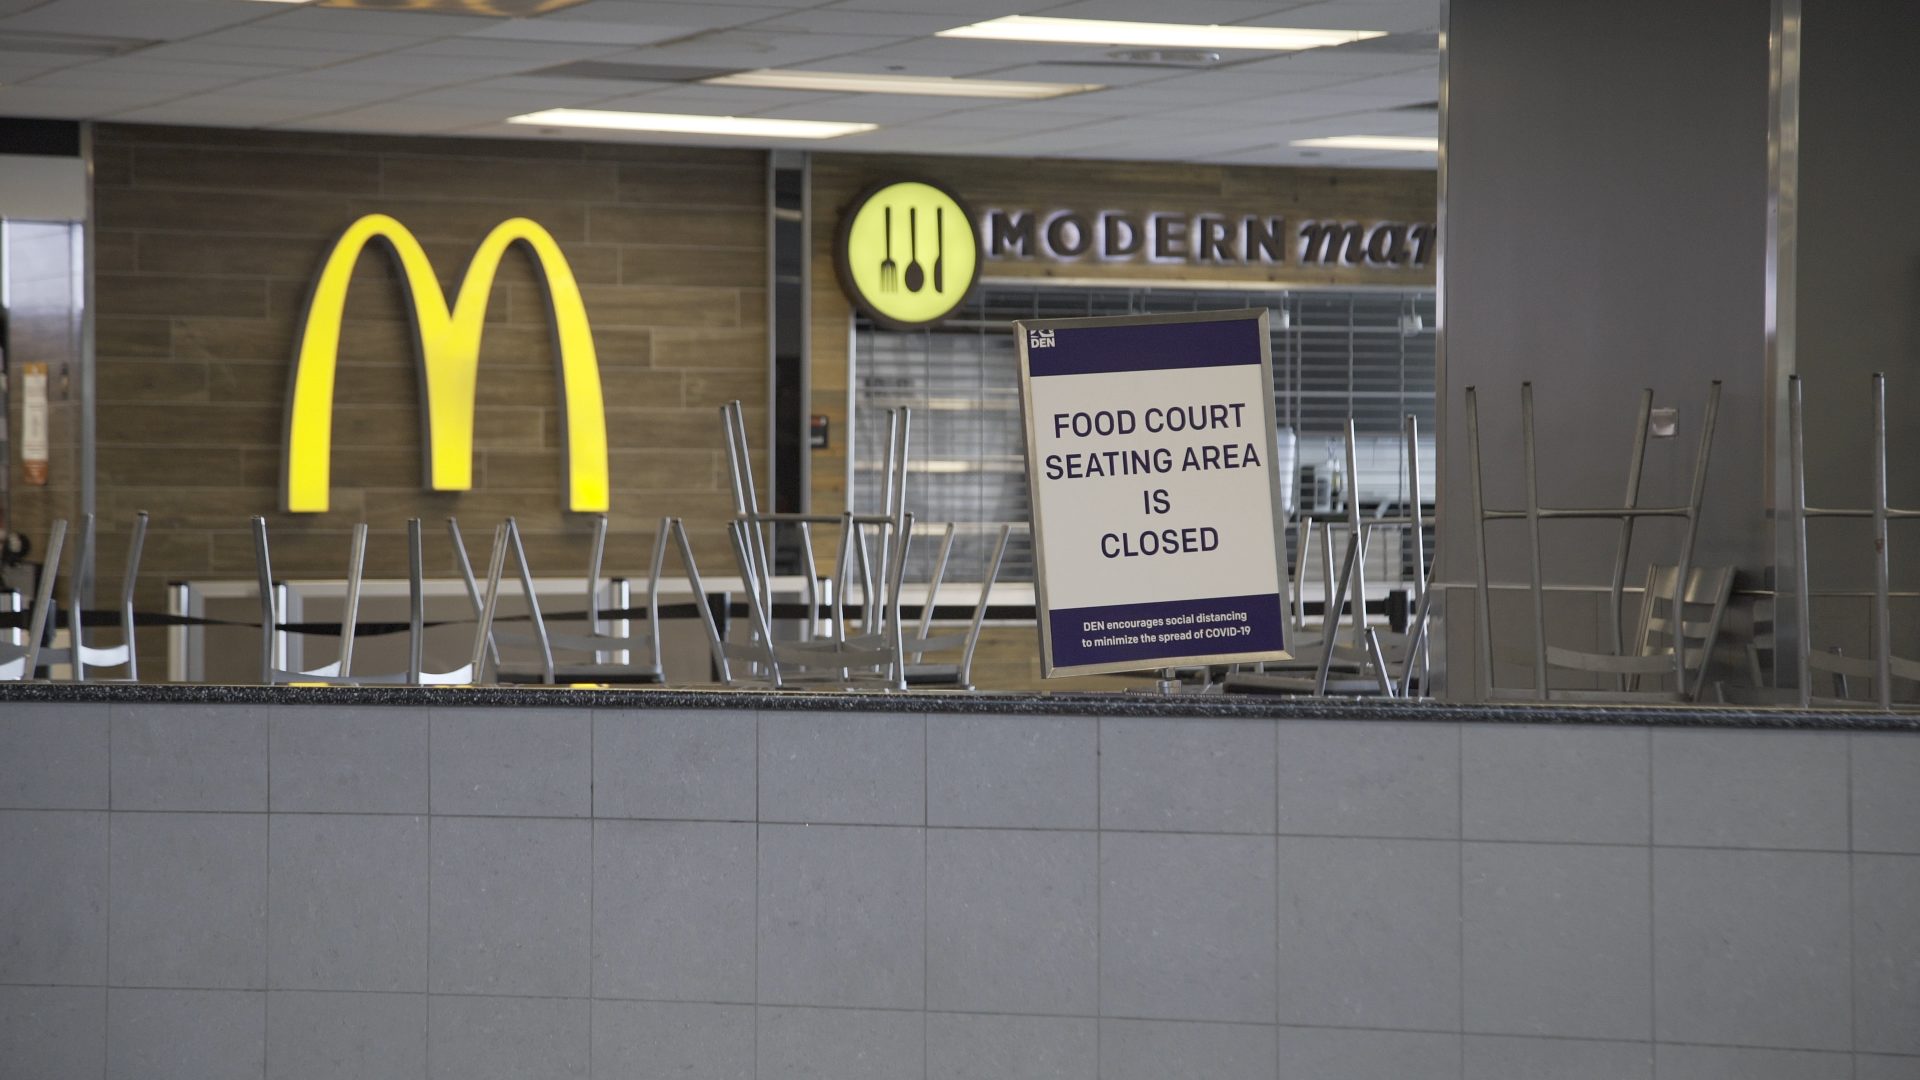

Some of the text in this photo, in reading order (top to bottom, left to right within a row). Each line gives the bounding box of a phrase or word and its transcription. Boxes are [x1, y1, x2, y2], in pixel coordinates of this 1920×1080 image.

[990, 212, 1287, 263] MODERN
[1031, 337, 1056, 348] DEN
[1054, 403, 1246, 438] FOOD COURT
[1045, 443, 1261, 480] SEATING AREA
[1144, 489, 1171, 515] IS
[1101, 527, 1219, 559] CLOSED
[1083, 610, 1248, 632] DEN encourages social distancing
[1082, 625, 1251, 648] to minimize the spread of COVID-19
